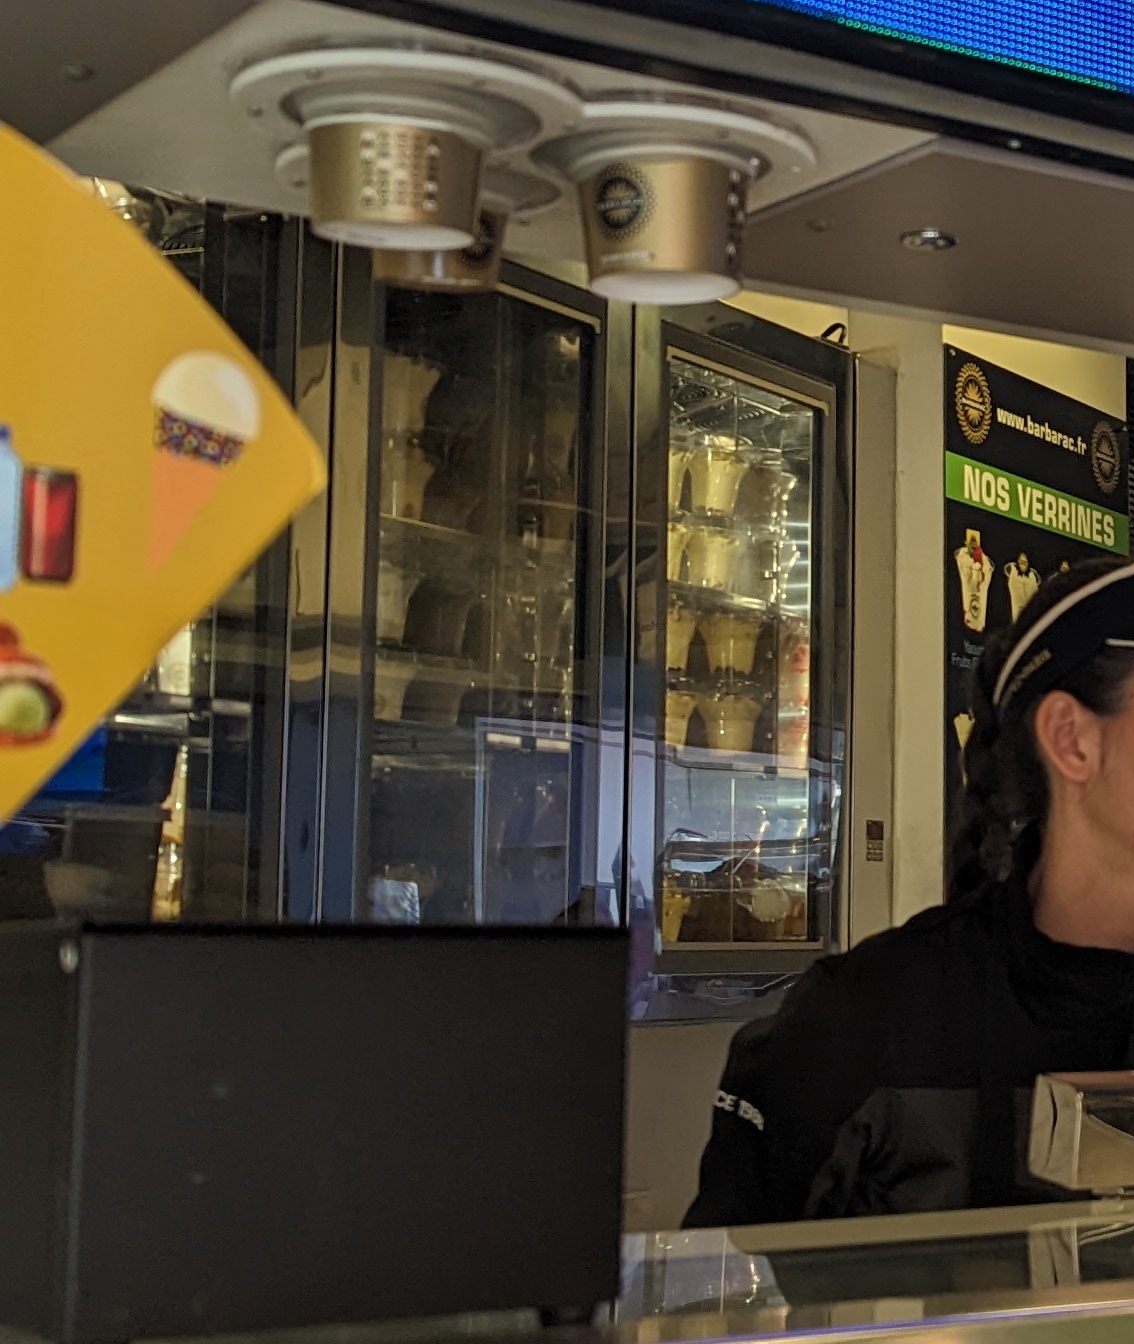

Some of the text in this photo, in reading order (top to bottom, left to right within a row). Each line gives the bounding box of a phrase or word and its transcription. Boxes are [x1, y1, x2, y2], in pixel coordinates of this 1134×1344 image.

[996, 407, 1088, 456] www.barbarac.fr
[963, 464, 1116, 547] NOS VERRINES
